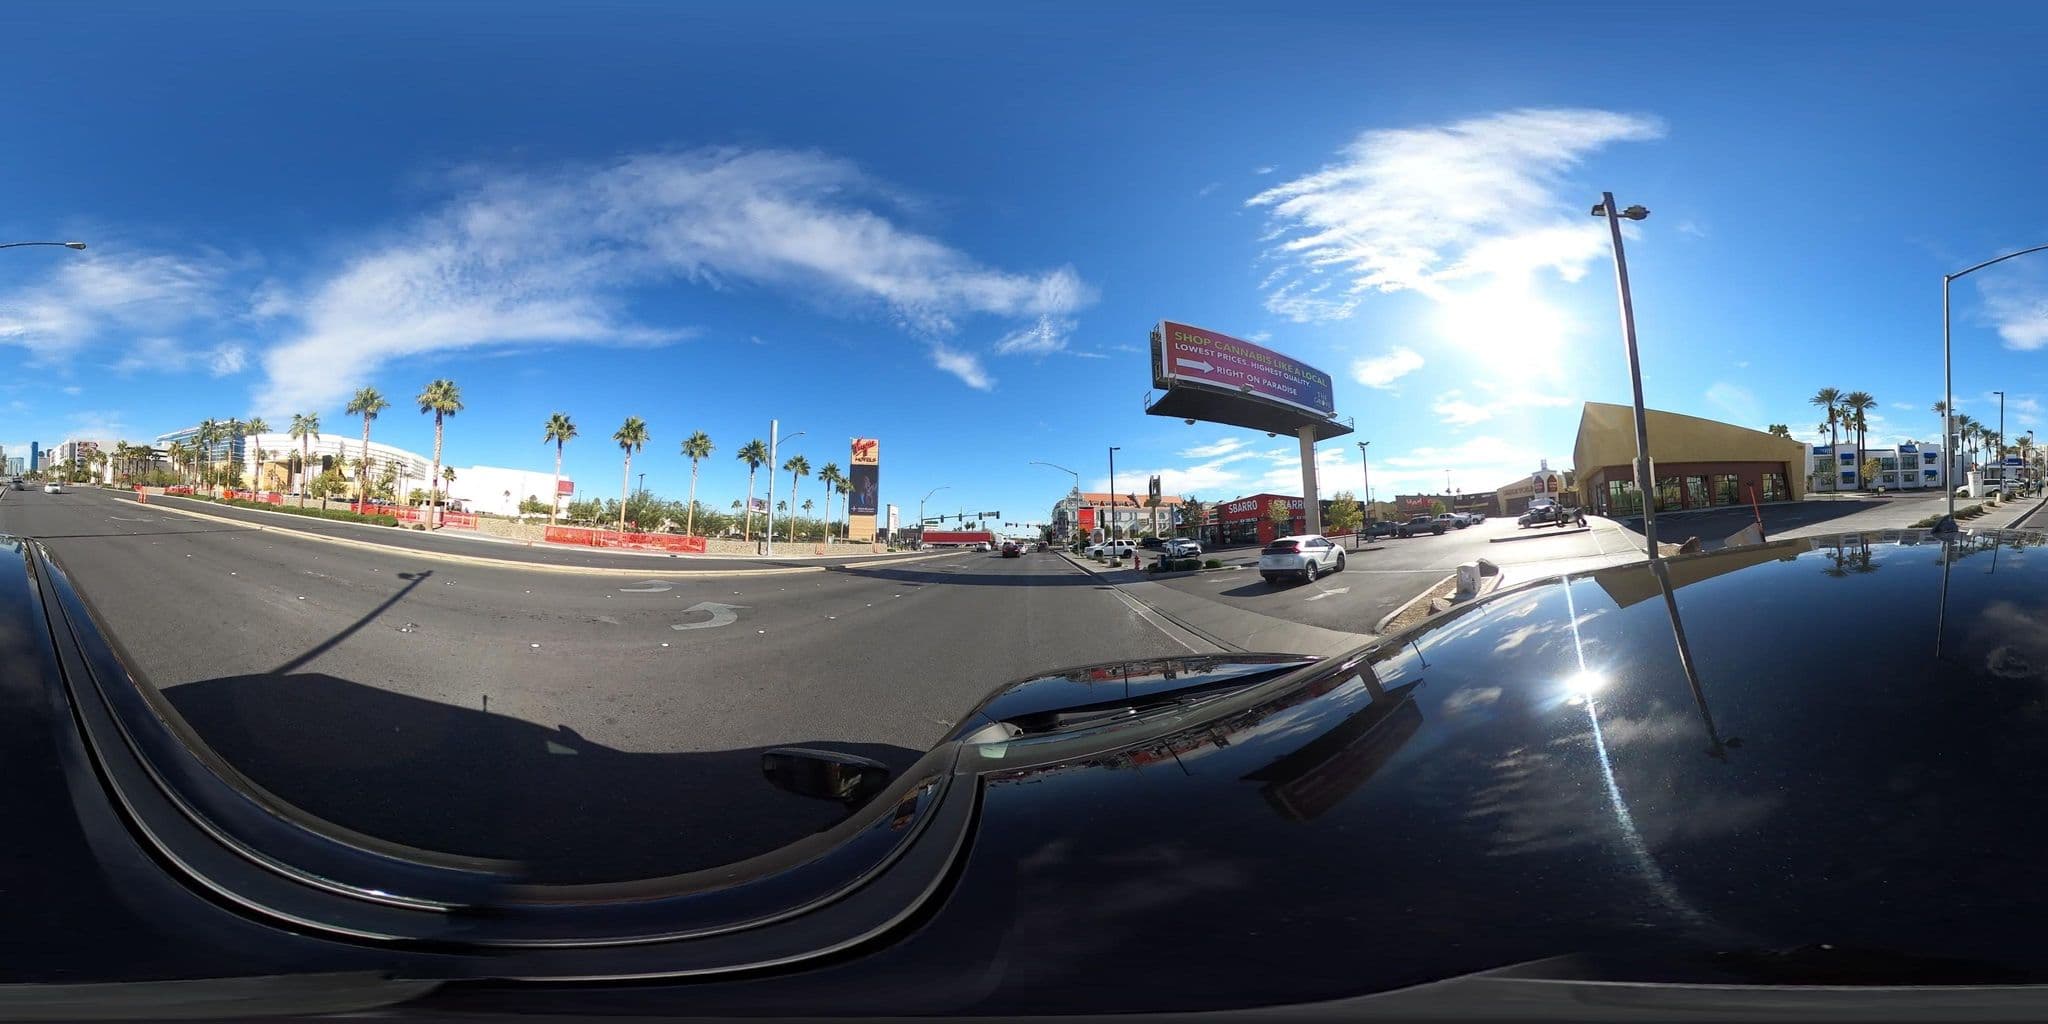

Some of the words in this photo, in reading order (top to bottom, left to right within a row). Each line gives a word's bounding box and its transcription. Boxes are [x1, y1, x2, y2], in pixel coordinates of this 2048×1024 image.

[1175, 332, 1211, 346] SHOP
[1215, 341, 1272, 364] CANNABIS
[1273, 358, 1294, 373] LIKE
[1293, 367, 1301, 376] A
[1175, 343, 1215, 357] LOWEST
[1250, 362, 1283, 378] HIGHEST
[1216, 366, 1244, 380] RIGHT
[1246, 373, 1260, 384] ON
[1262, 377, 1298, 396] PARADISE
[1228, 500, 1258, 514] SBARRO
